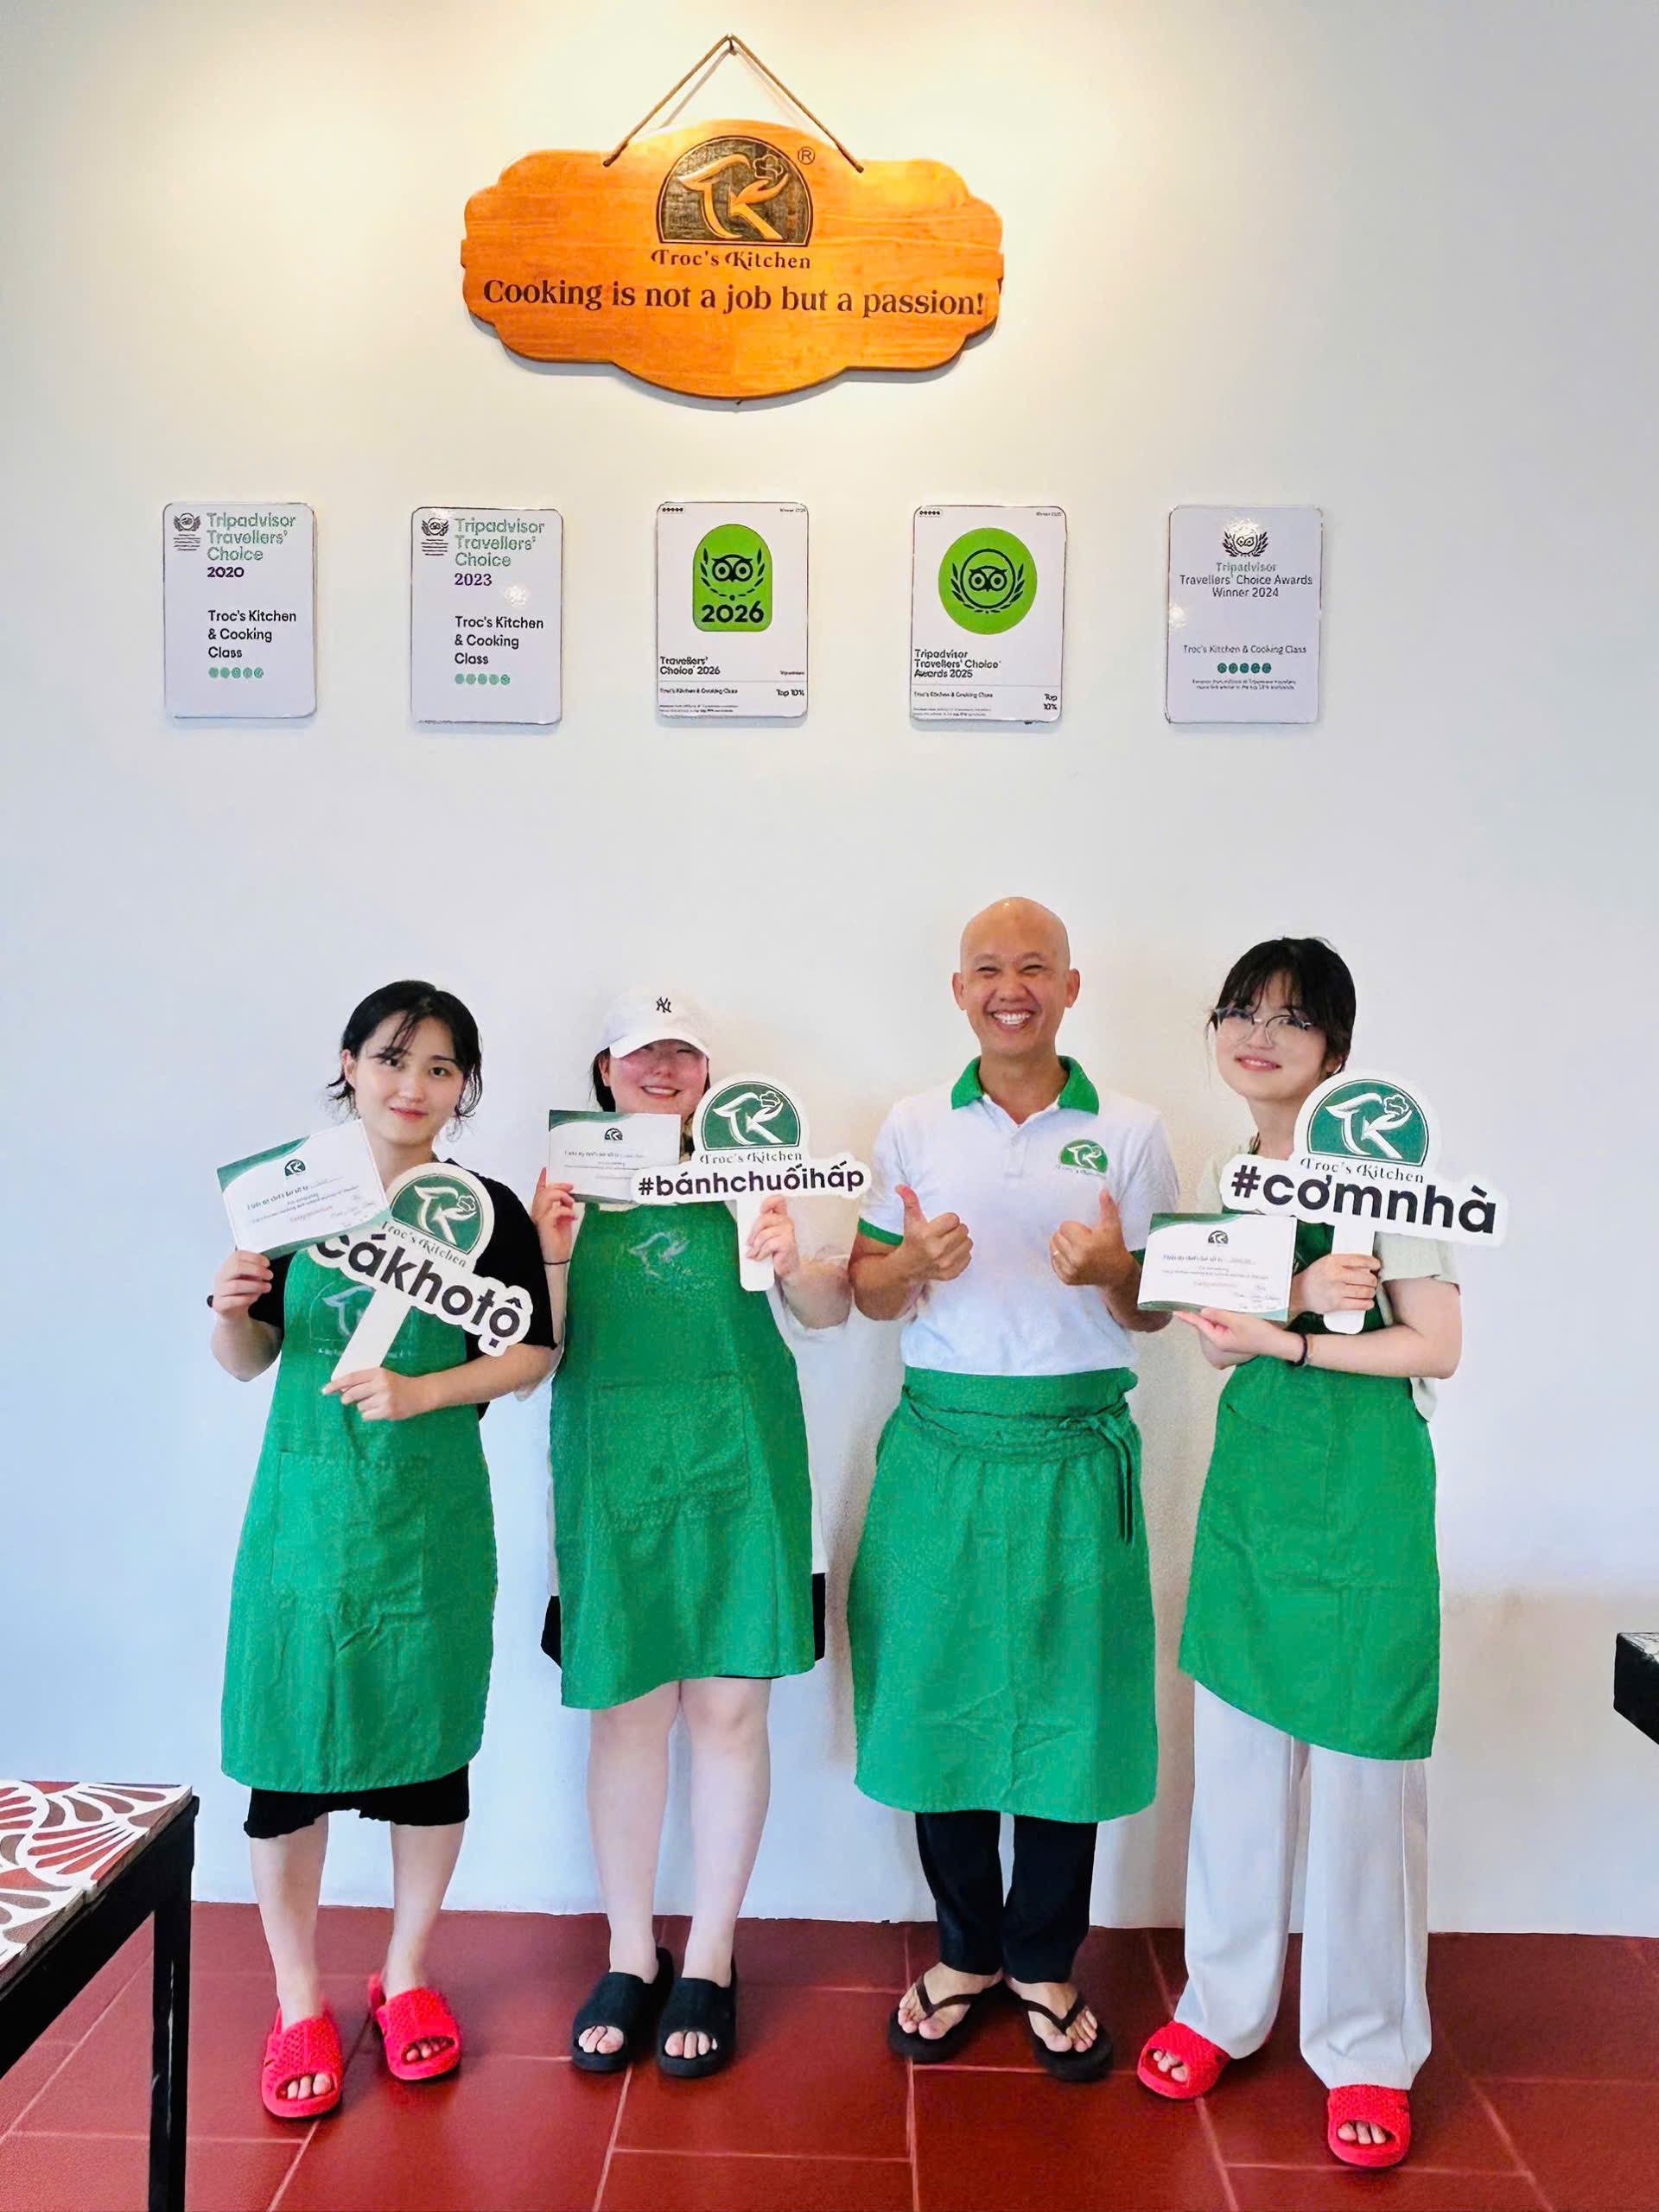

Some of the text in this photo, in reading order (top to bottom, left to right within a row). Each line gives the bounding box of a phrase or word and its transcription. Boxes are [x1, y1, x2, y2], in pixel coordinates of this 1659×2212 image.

[651, 249, 810, 270] Troc's Kitchen
[483, 279, 984, 318] Cooking is not a job but a passion!
[207, 512, 296, 531] Tripadvisor
[454, 518, 544, 536] Tripadvisor
[207, 530, 288, 544] Travellers'
[454, 535, 536, 550] Travellers'
[207, 547, 264, 561] Choice
[454, 552, 512, 567] Choice
[207, 566, 245, 578] 2020
[1216, 562, 1277, 575] Tripadvisor
[454, 573, 493, 586] 2023
[1180, 575, 1313, 585] Travellers' Choice Awards
[1212, 588, 1279, 598] Winner 2024
[207, 610, 296, 622] Troc's Kitchen
[701, 601, 765, 623] 2026
[454, 616, 543, 629] Troc's Kitchen
[207, 627, 272, 643] & Cooking
[454, 634, 519, 650] & Cooking
[207, 646, 243, 658] Class
[915, 649, 968, 659] Tripadvisor
[1184, 645, 1207, 653] Troc's
[1210, 645, 1240, 653] Kitchen
[1250, 645, 1283, 655] Cooking
[454, 652, 489, 664] Class
[697, 666, 721, 675] 2026
[914, 669, 973, 678] Awards 2025
[656, 996, 671, 1013] NY
[700, 1151, 802, 1164] Troc's Kitchen
[1300, 1158, 1424, 1183] Troc's Kitchen
[639, 1161, 864, 1196] #bánhchuốihấp
[1231, 1164, 1496, 1234] #cơmnhà
[419, 1238, 467, 1268] Kitchen
